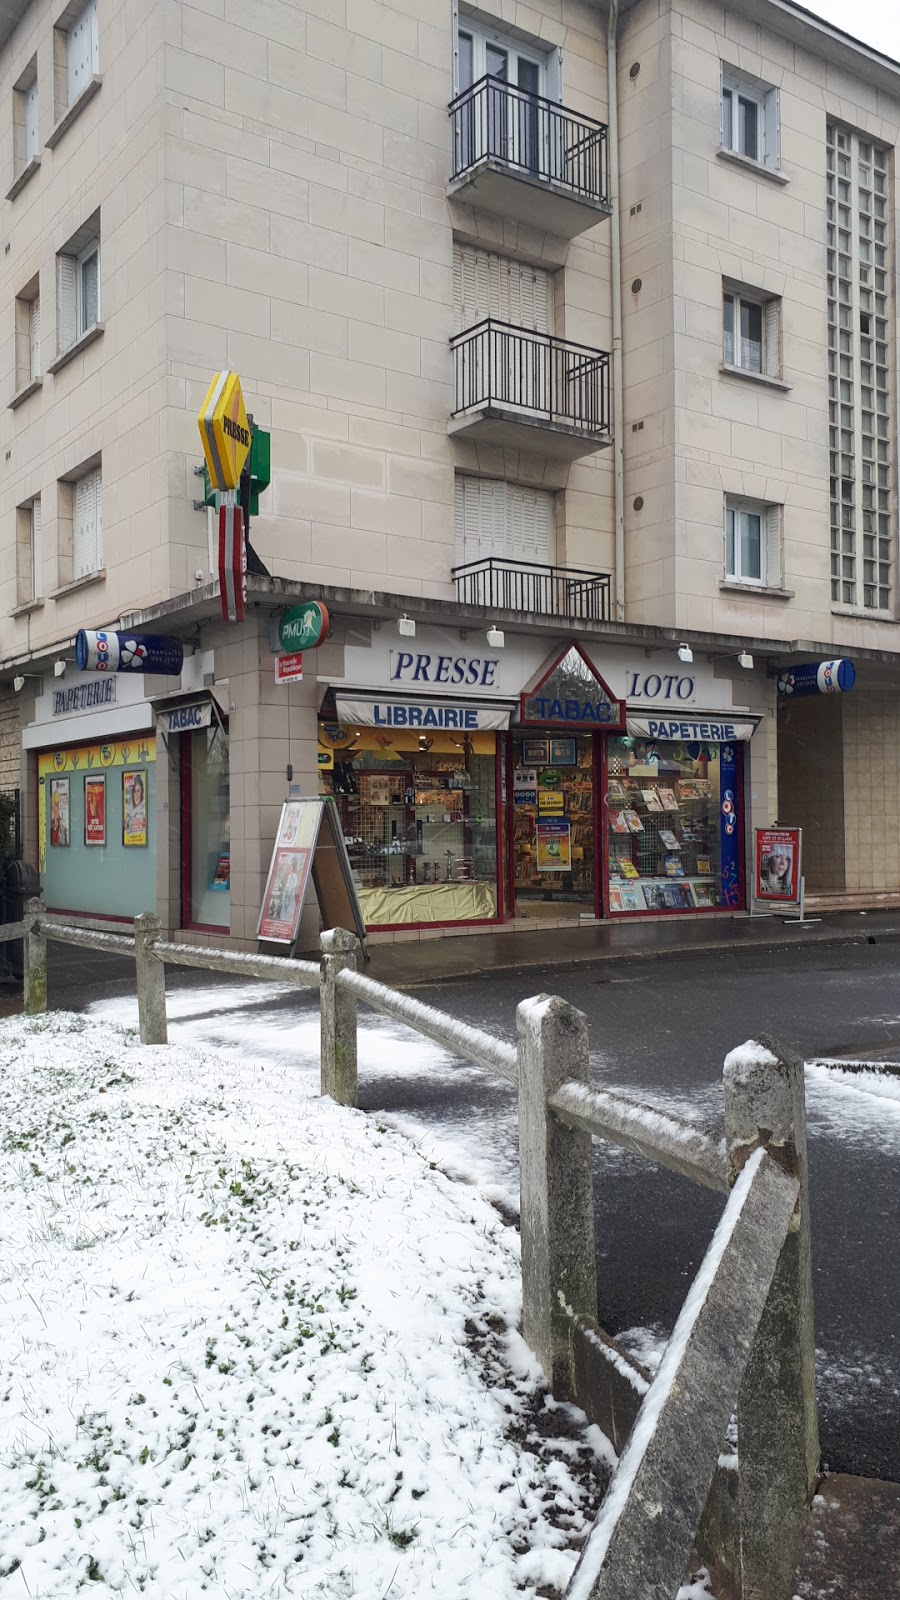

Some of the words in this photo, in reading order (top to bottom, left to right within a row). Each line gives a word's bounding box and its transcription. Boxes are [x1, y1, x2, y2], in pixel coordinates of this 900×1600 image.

[223, 415, 249, 448] PRESSE
[282, 620, 304, 640] PMU
[393, 652, 500, 686] PRESSE
[824, 661, 836, 692] LOTO
[55, 678, 113, 714] PAPETERIE
[629, 673, 694, 700] LOTO
[168, 707, 202, 730] TABAC
[374, 705, 479, 728] LIBRAIRIE
[537, 698, 612, 723] TABAC
[648, 721, 737, 740] PAPETERIE
